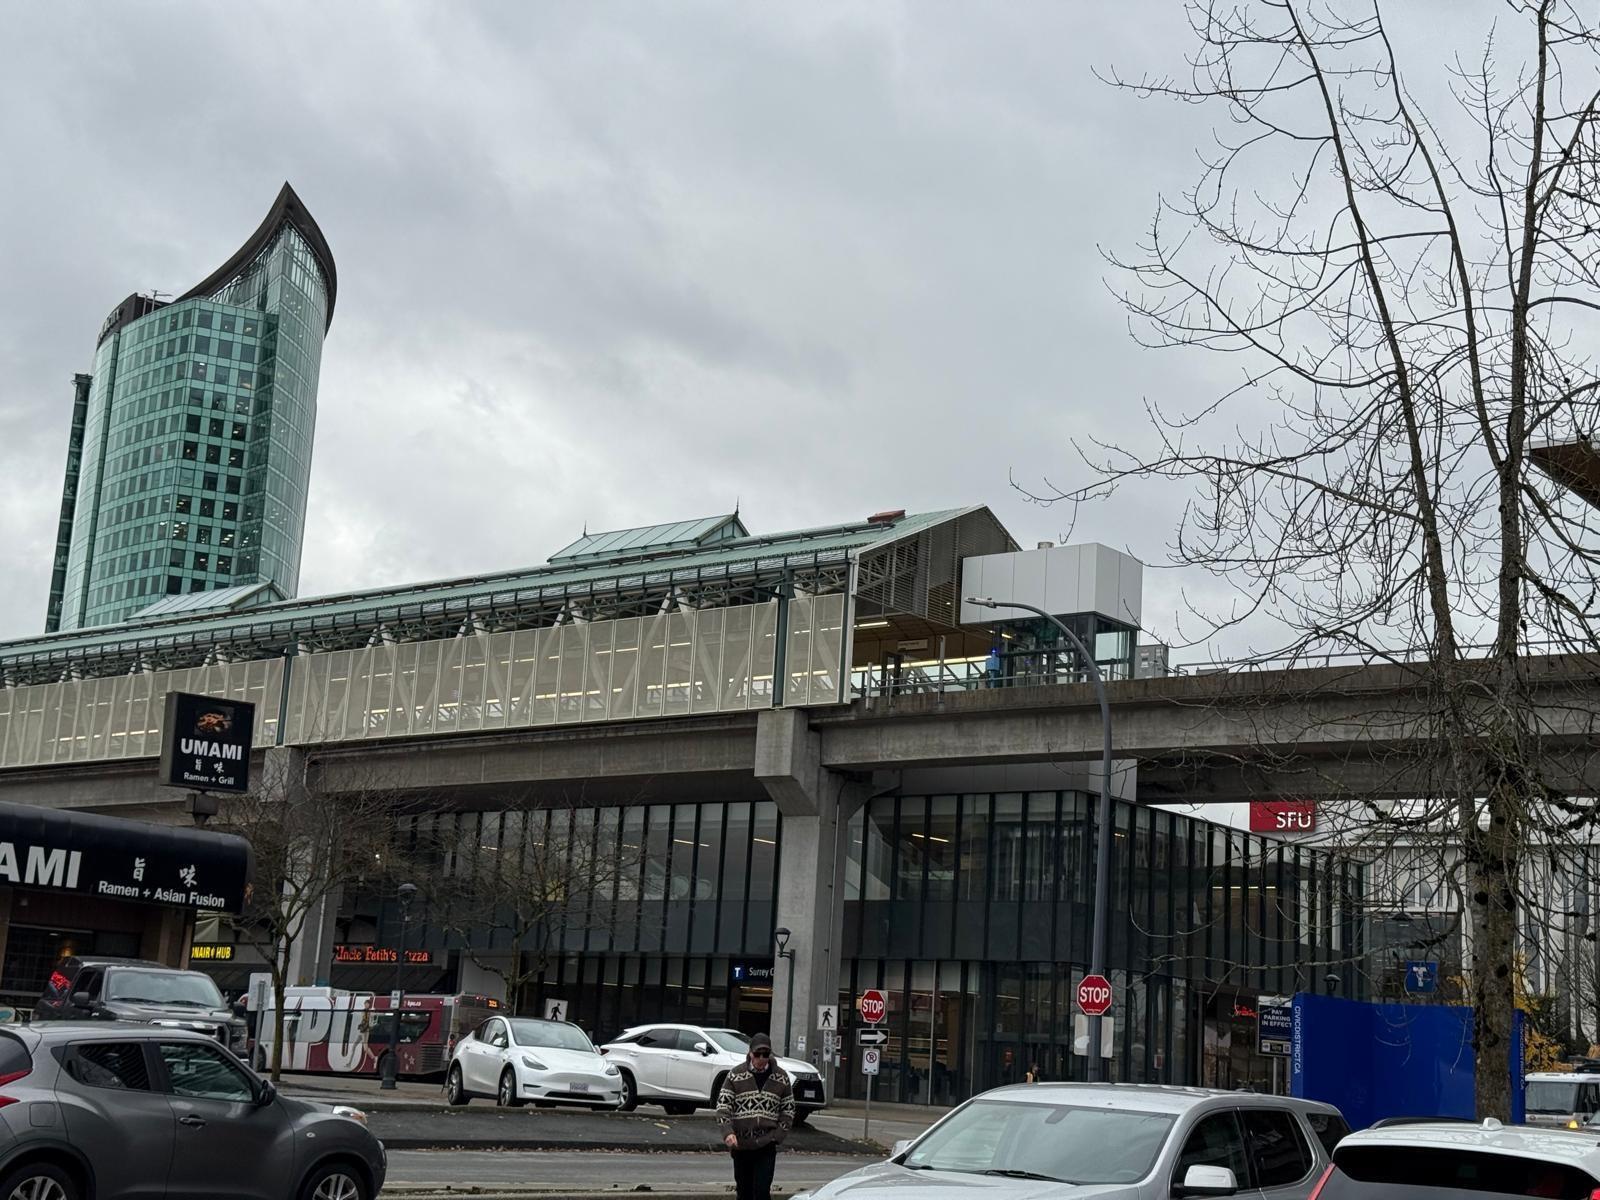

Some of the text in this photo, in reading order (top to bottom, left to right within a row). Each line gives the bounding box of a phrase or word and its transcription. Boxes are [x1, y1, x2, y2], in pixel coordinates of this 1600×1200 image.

[181, 738, 242, 760] UMAMI
[183, 772, 208, 782] Ramen
[218, 776, 234, 785] Grill
[1276, 811, 1311, 828] SFU
[98, 880, 139, 898] Ramen
[153, 888, 186, 904] Asian
[189, 892, 225, 908] Fusion
[216, 946, 231, 959] HUB
[336, 945, 362, 961] Uncle
[749, 967, 769, 978] Surrey
[1080, 986, 1110, 1003] STOP
[862, 999, 884, 1014] STOP
[1263, 1014, 1291, 1022] PARKING
